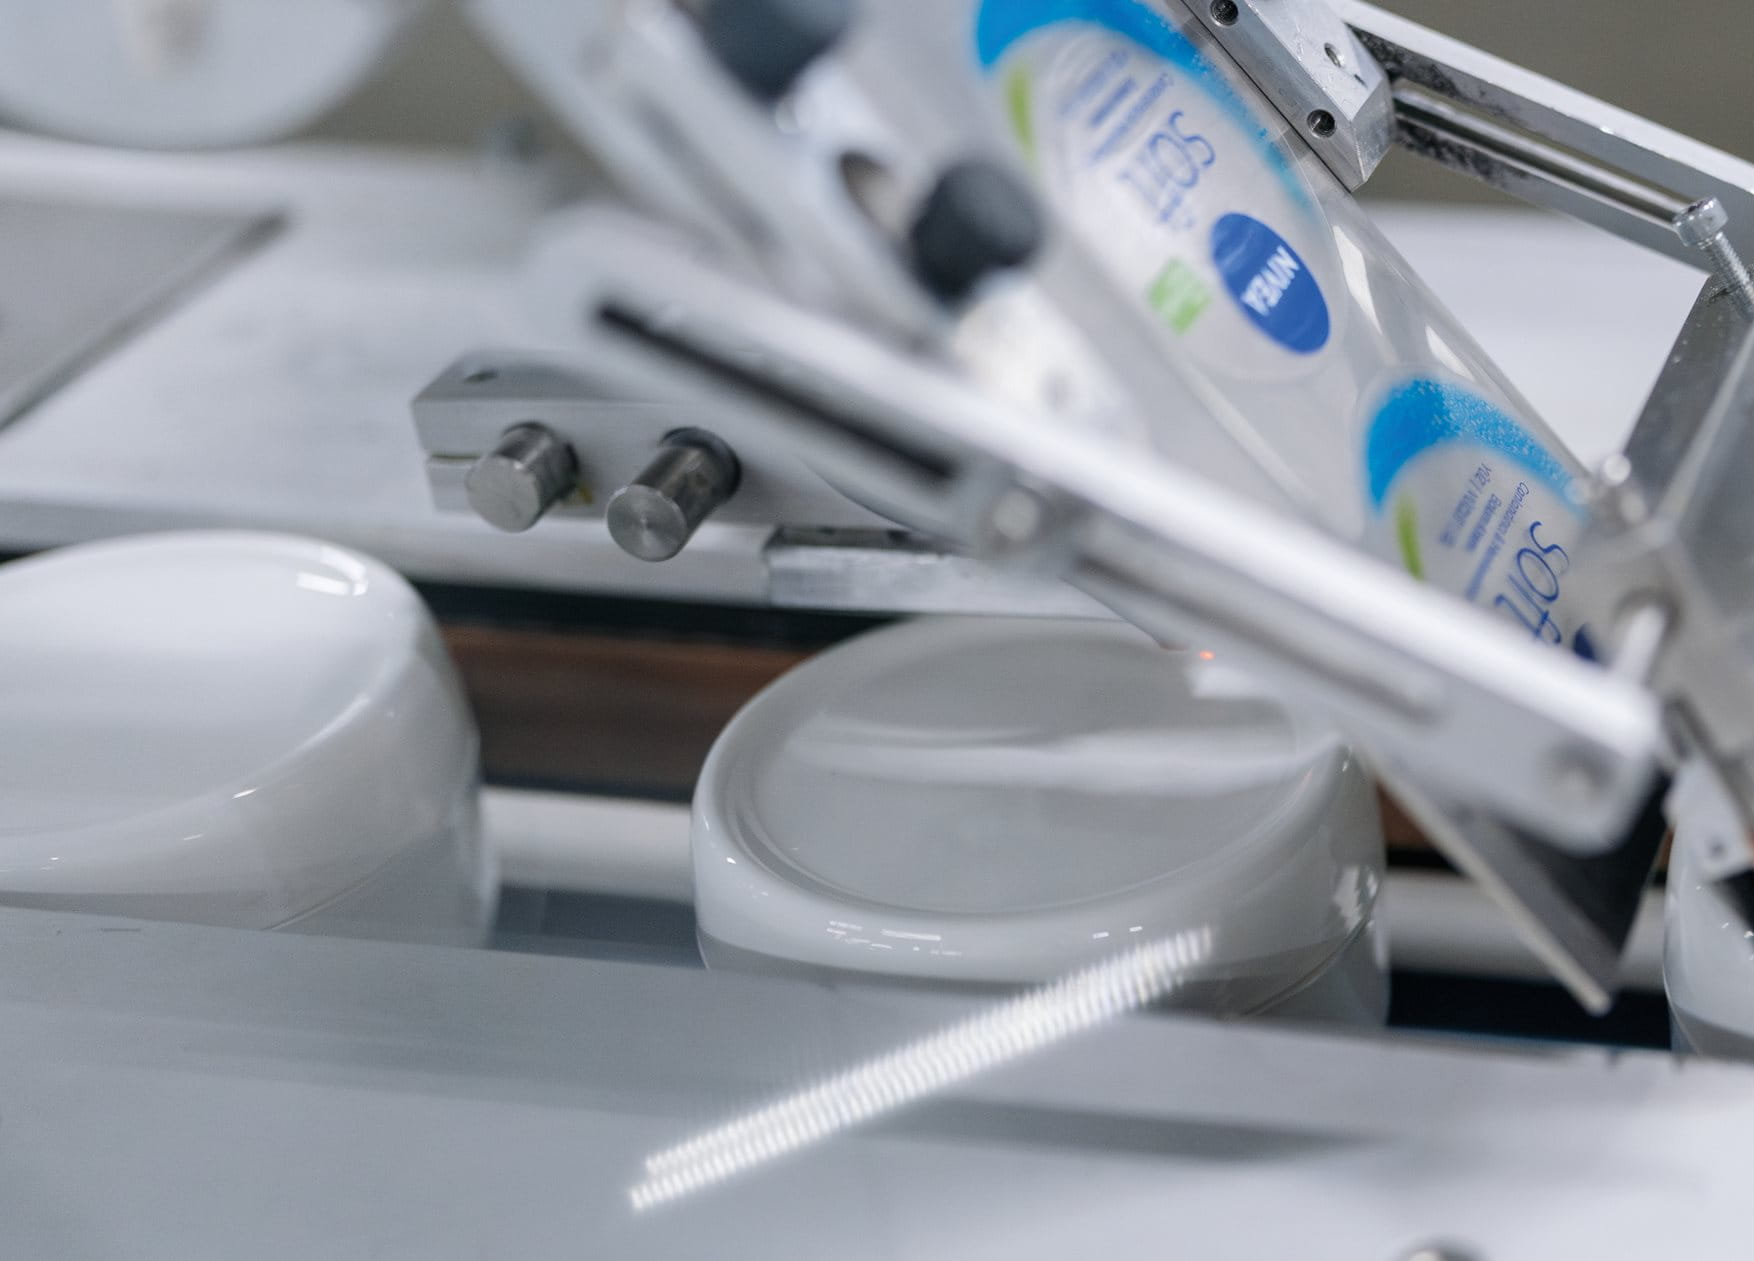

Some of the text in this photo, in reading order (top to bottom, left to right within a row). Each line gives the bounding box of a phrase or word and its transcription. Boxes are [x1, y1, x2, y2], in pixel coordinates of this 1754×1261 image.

[1117, 110, 1216, 232] soft
[1241, 245, 1299, 316] NIVEA
[1494, 521, 1569, 645] soft
